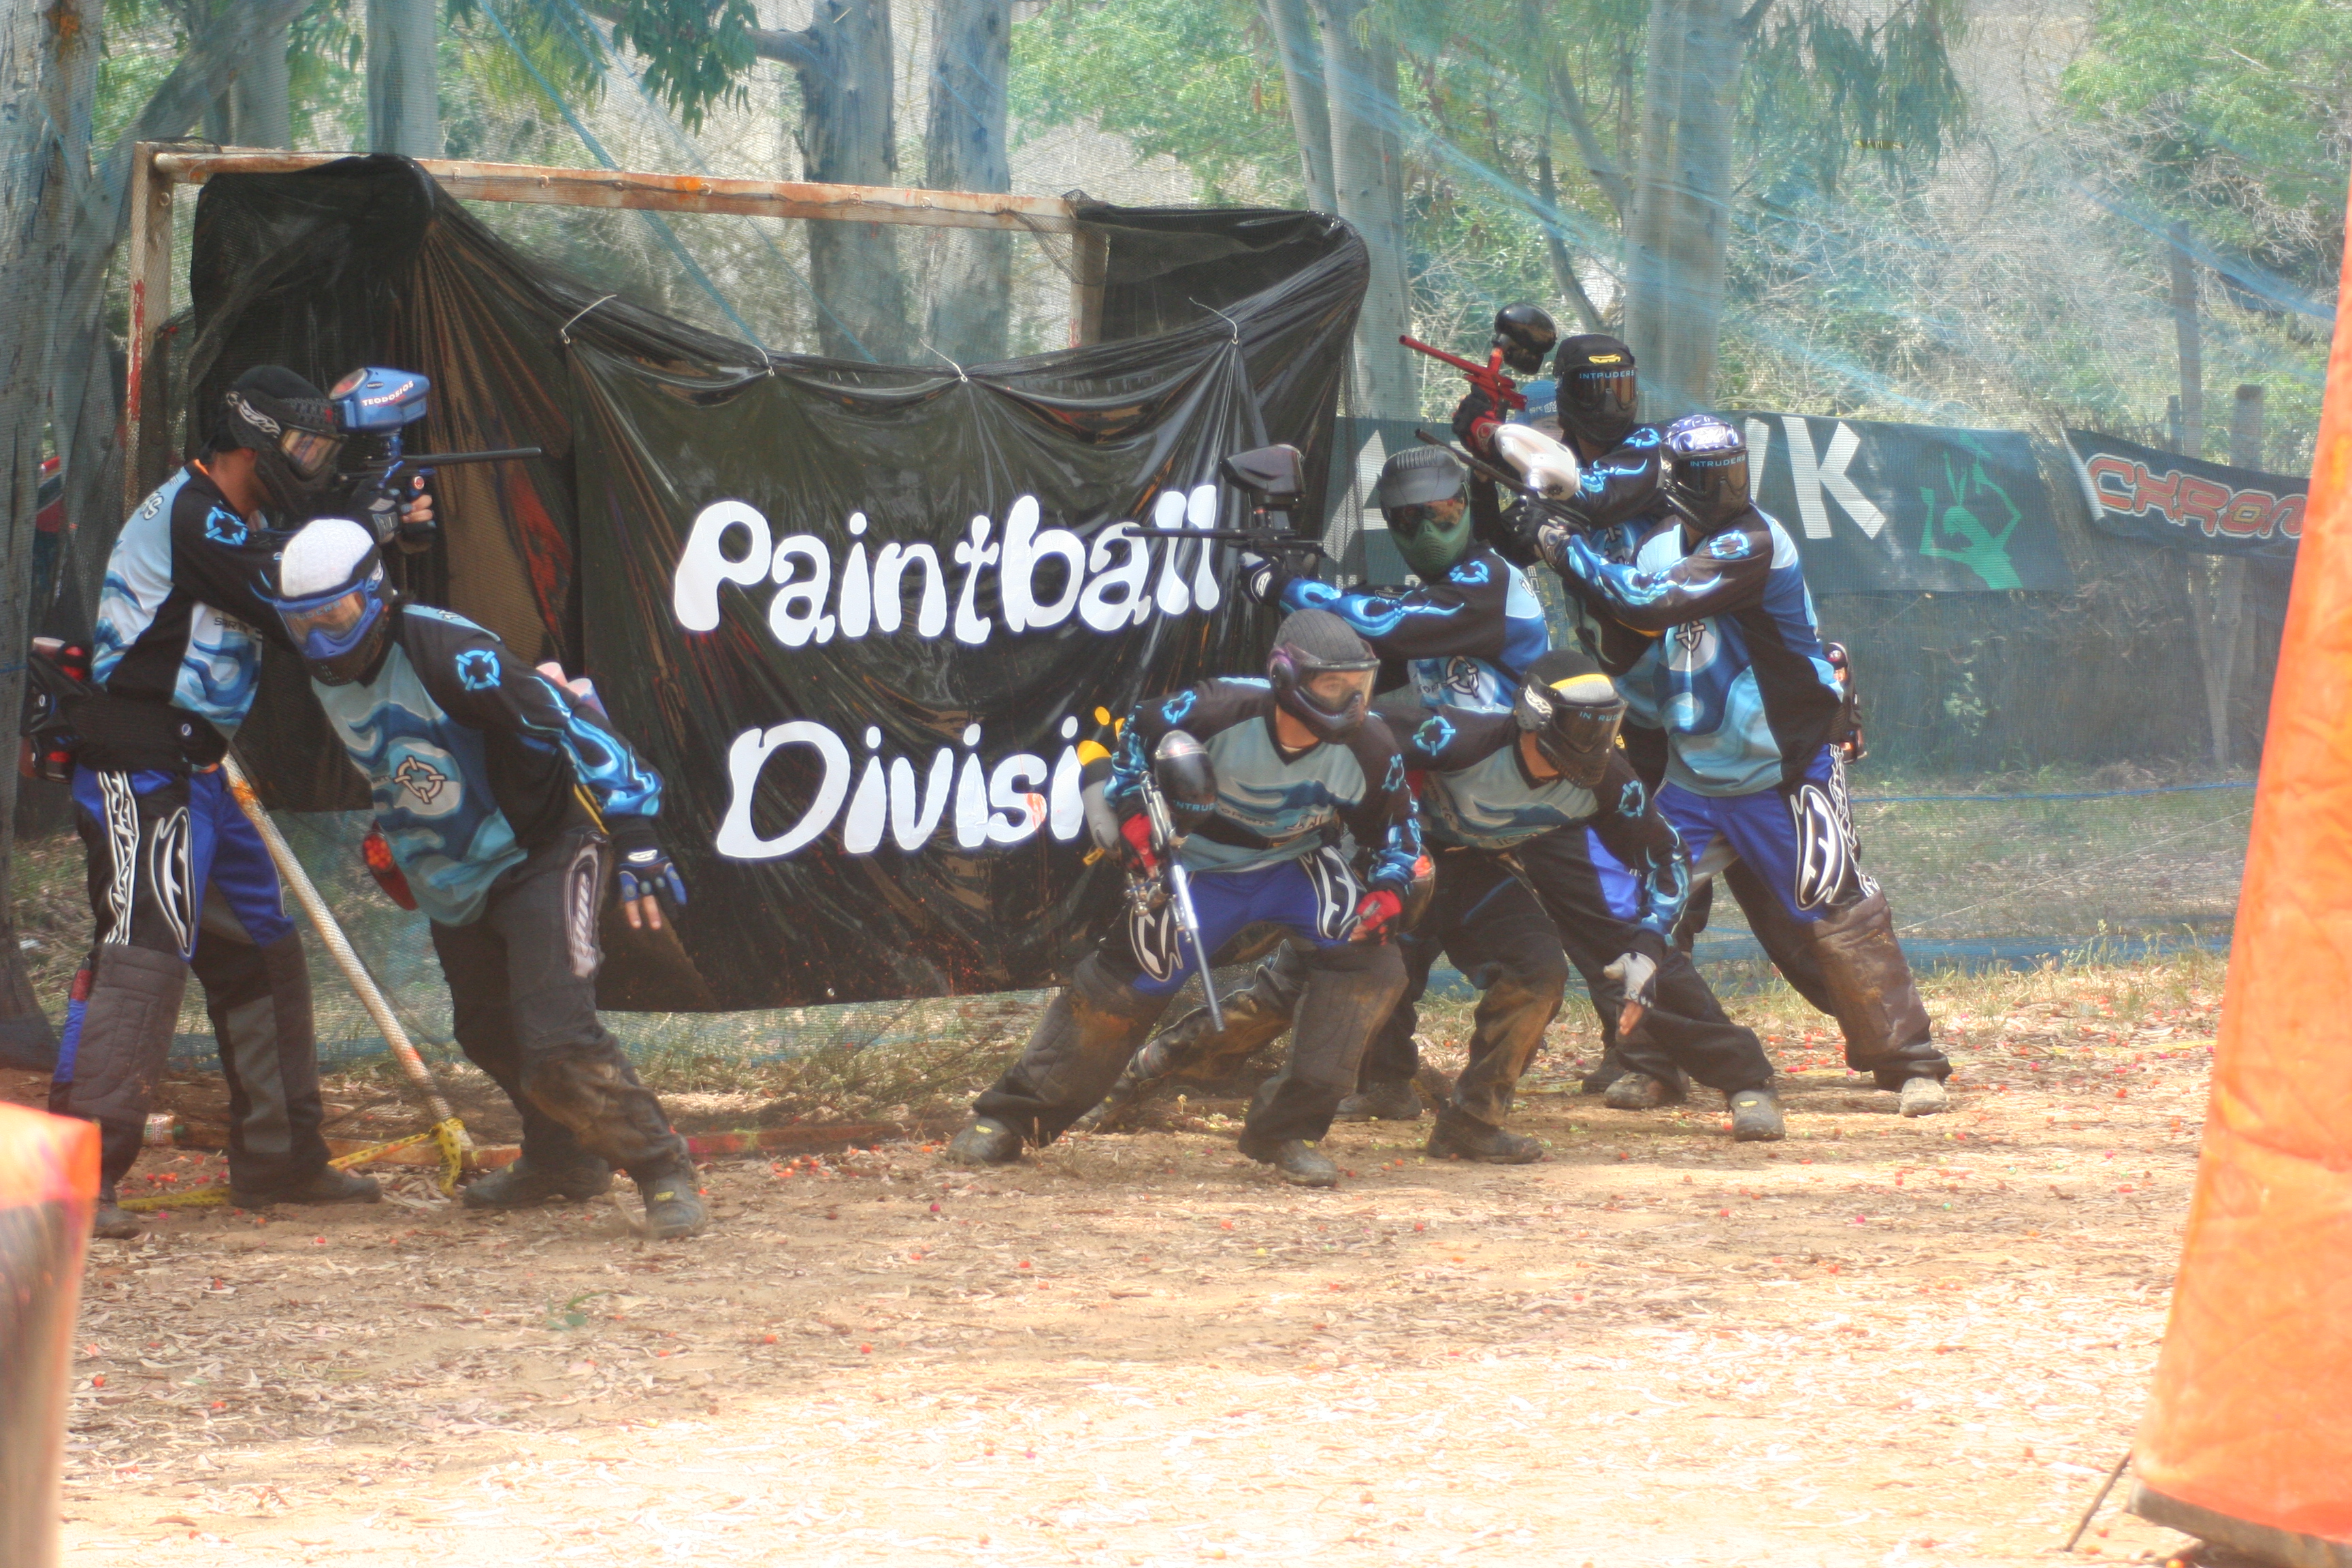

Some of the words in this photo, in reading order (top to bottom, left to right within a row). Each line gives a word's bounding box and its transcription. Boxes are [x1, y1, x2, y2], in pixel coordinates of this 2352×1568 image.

[361, 380, 414, 406] TEODOSIOS
[1690, 454, 1746, 467] INTRUDERS
[674, 484, 1220, 647] Paintball
